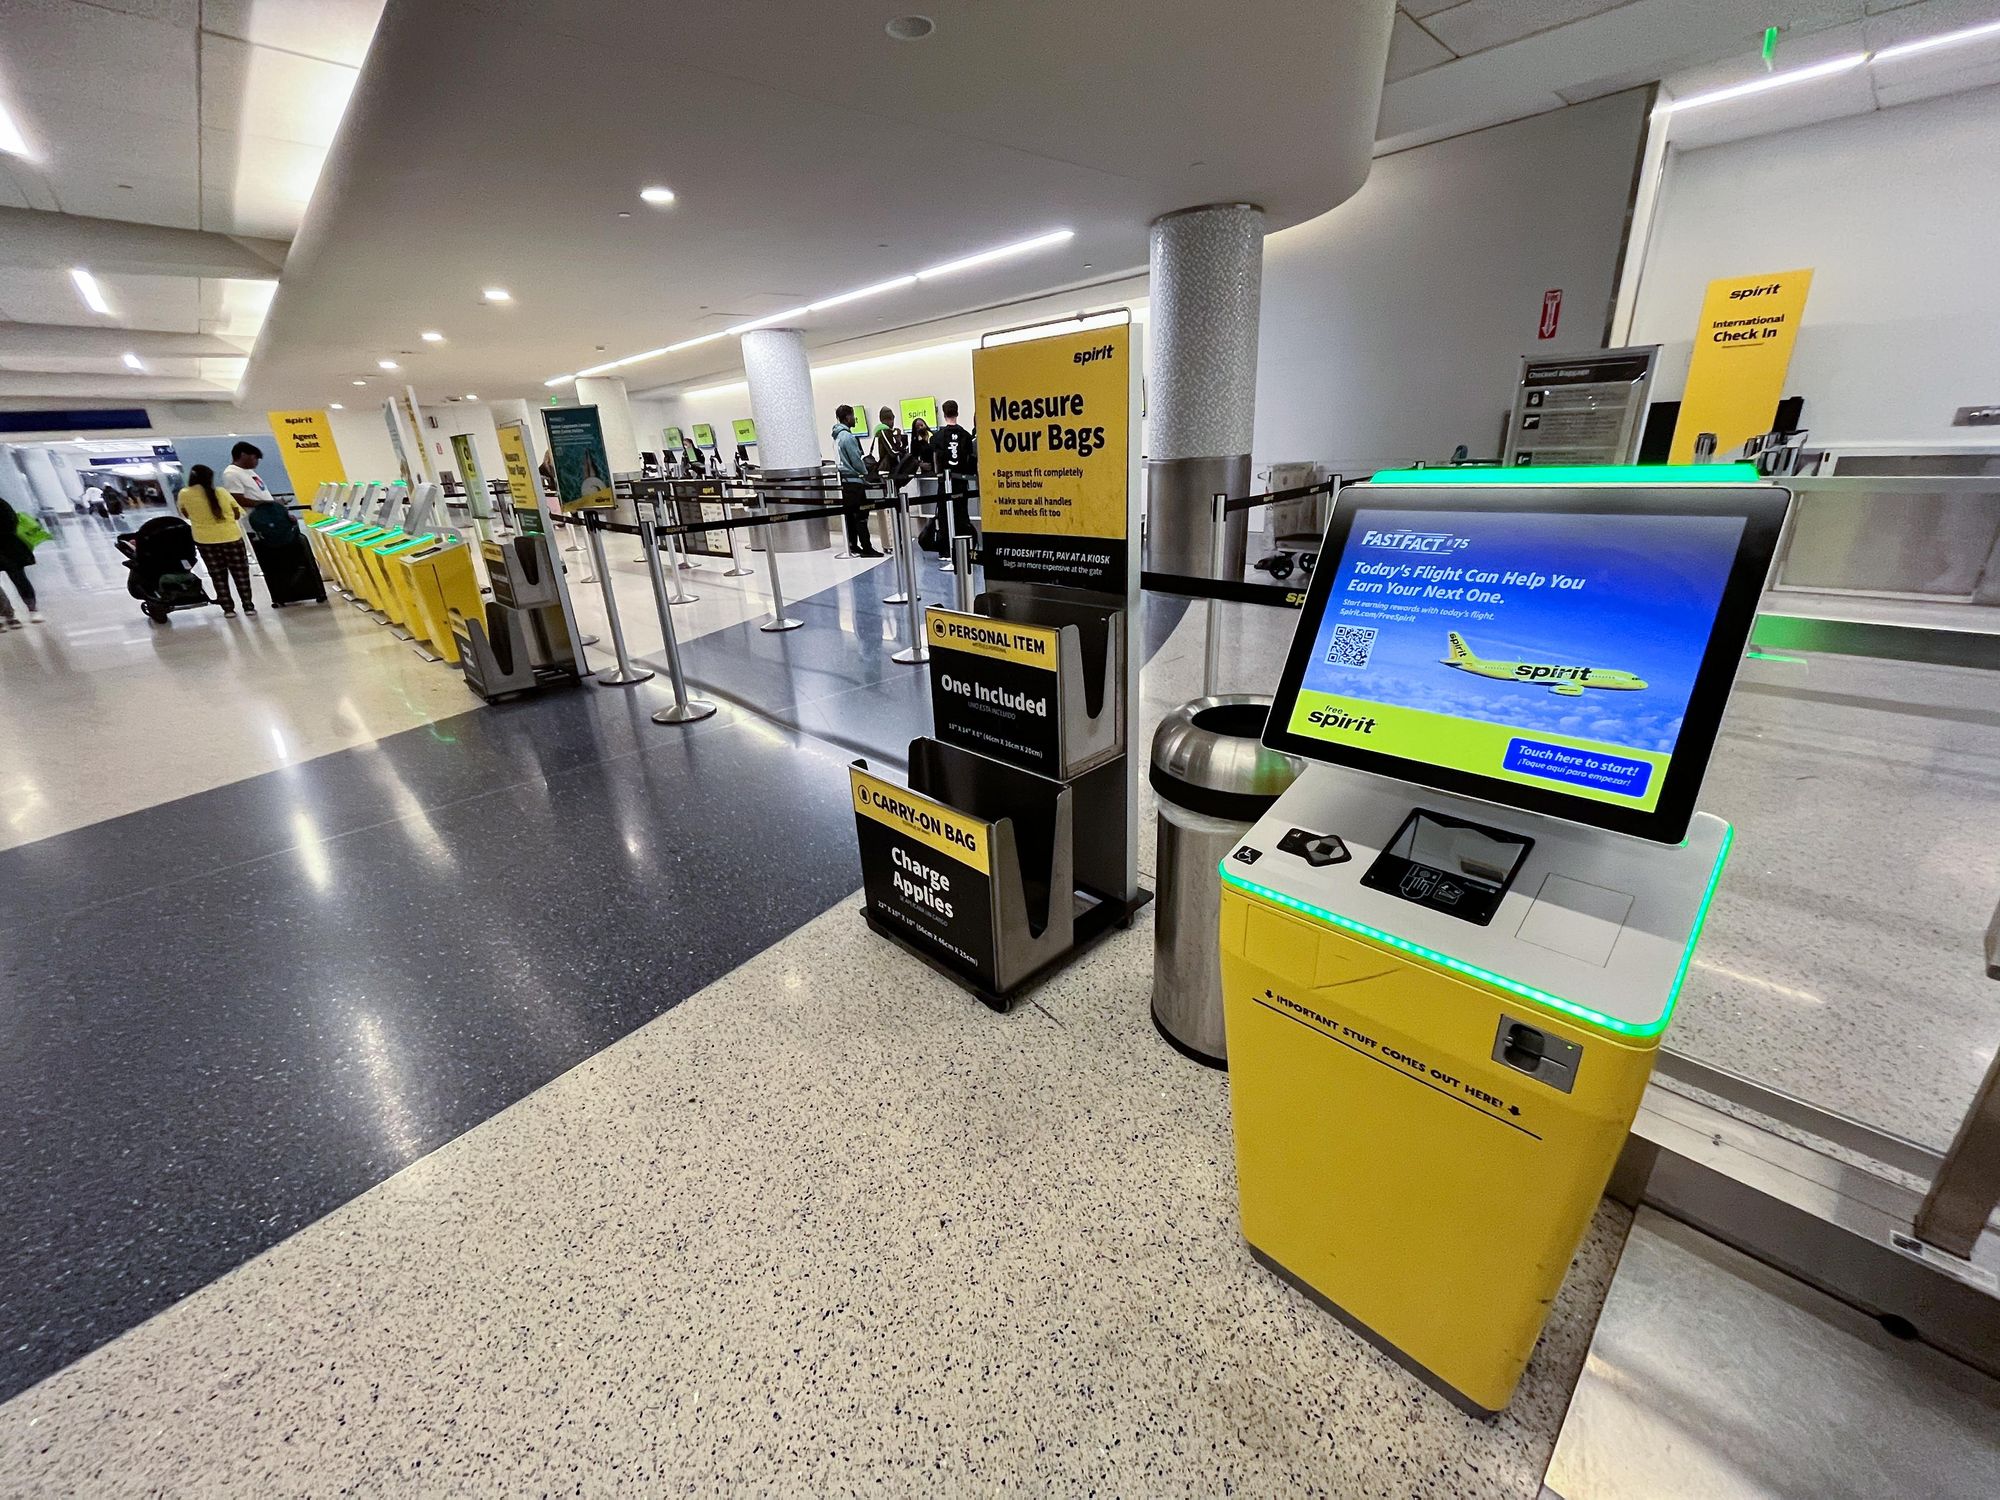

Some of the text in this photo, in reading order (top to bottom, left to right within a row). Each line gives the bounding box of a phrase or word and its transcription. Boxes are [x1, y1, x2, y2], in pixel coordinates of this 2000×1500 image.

[1729, 284, 1782, 300] spirit
[1713, 314, 1784, 328] International
[1714, 328, 1776, 342] Check In
[1073, 345, 1114, 365] spirit
[908, 410, 926, 418] spirit
[990, 394, 1084, 422] Measure
[284, 416, 313, 424] spirit
[990, 424, 1104, 457] Your Bags
[997, 467, 1084, 479] Bags must fit completely
[998, 480, 1043, 488] in bins below
[998, 497, 1072, 506] Make sure all handles
[1000, 508, 1061, 517] and wheels fit too
[996, 548, 1111, 564] IF IT DOESN'T FIT, PAY AT A KIOSK
[1003, 560, 1016, 569] Bags
[1026, 562, 1042, 570] more
[1042, 564, 1070, 573] expensive
[1078, 566, 1088, 574] the
[1089, 568, 1102, 577] gate
[1354, 562, 1586, 590] Today's Flight Can Help You
[1347, 579, 1505, 604] Earn Your Next One.
[1340, 608, 1416, 623] Spirit.com/FreeSpirit
[1343, 598, 1495, 621] Start earning rewards with today's flight.
[949, 624, 1010, 648] PERSONAL
[1014, 635, 1044, 654] ITEM
[1449, 632, 1467, 658] spirit
[1515, 664, 1592, 681] spirit
[942, 674, 1046, 717] One Included
[1325, 705, 1344, 715] free
[1308, 710, 1376, 734] spirit
[1518, 745, 1640, 777] Touch here to start!
[1517, 758, 1631, 787] ¡Toque aquí para empezar!
[873, 792, 941, 836] CARRY-ON
[944, 823, 976, 852] BAG
[892, 847, 950, 891] Charge
[893, 871, 954, 918] Applies
[1277, 995, 1504, 1108] IMPORTANT STUFF COMES OUT HERE!
